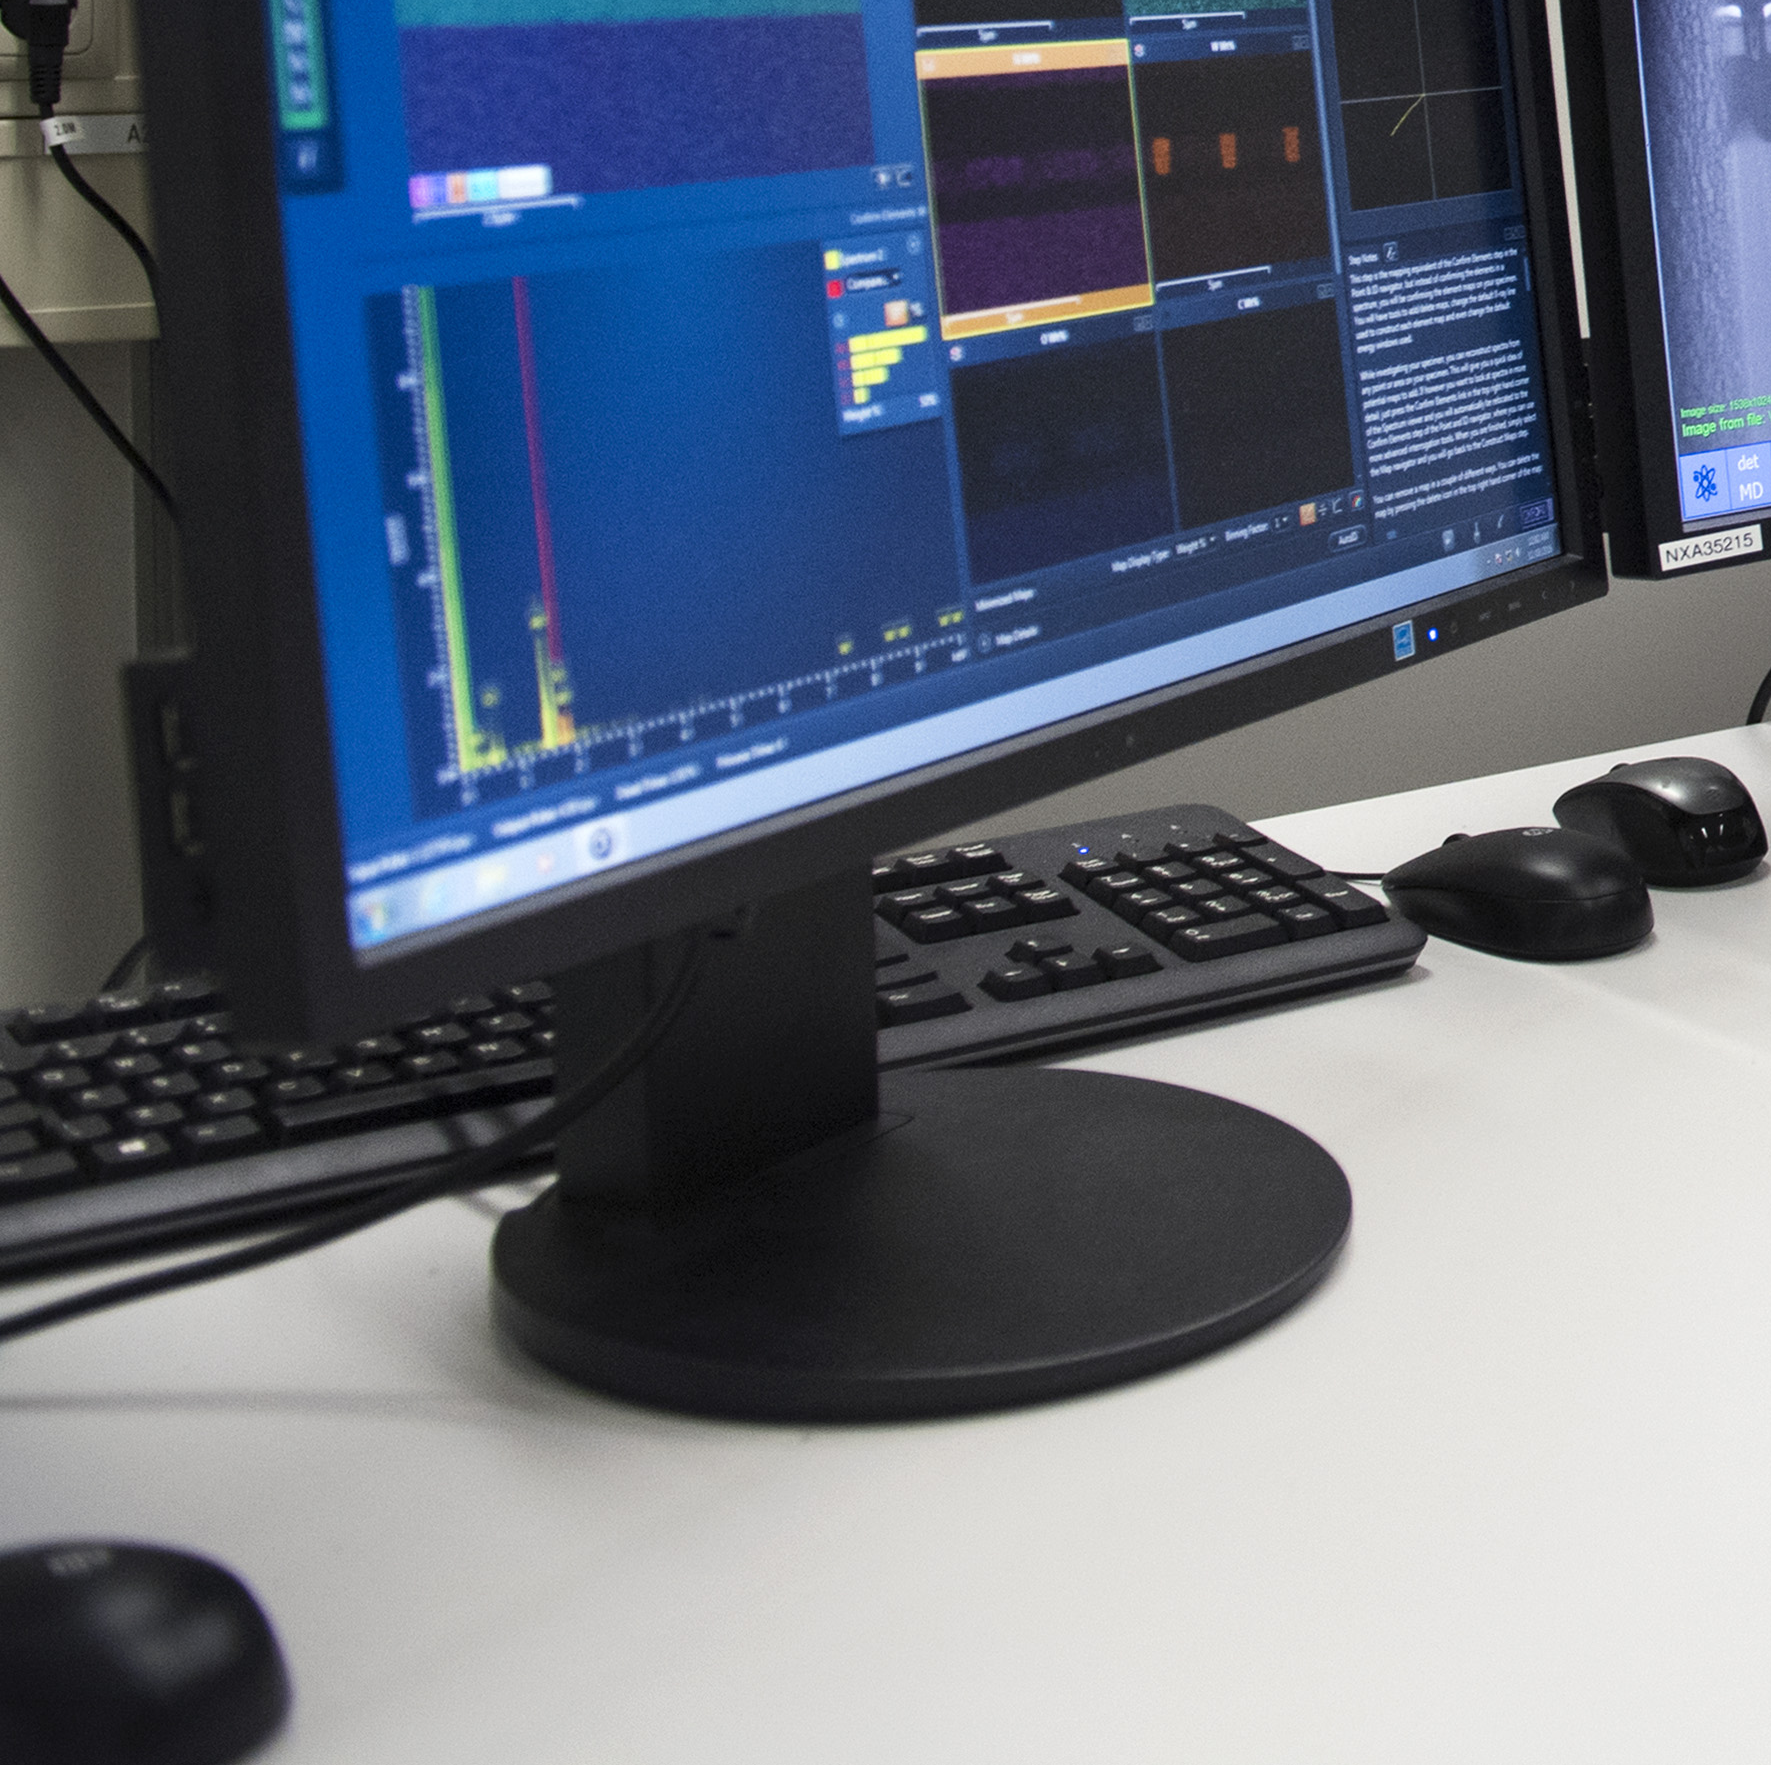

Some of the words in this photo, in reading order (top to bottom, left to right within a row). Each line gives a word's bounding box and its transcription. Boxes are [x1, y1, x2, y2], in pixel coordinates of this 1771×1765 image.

[1680, 406, 1706, 418] Image
[1682, 423, 1717, 438] Image
[1719, 417, 1744, 430] from
[1747, 413, 1766, 427] file:
[1738, 454, 1760, 472] det
[1740, 481, 1764, 502] MD
[1665, 532, 1754, 563] NXA35215
